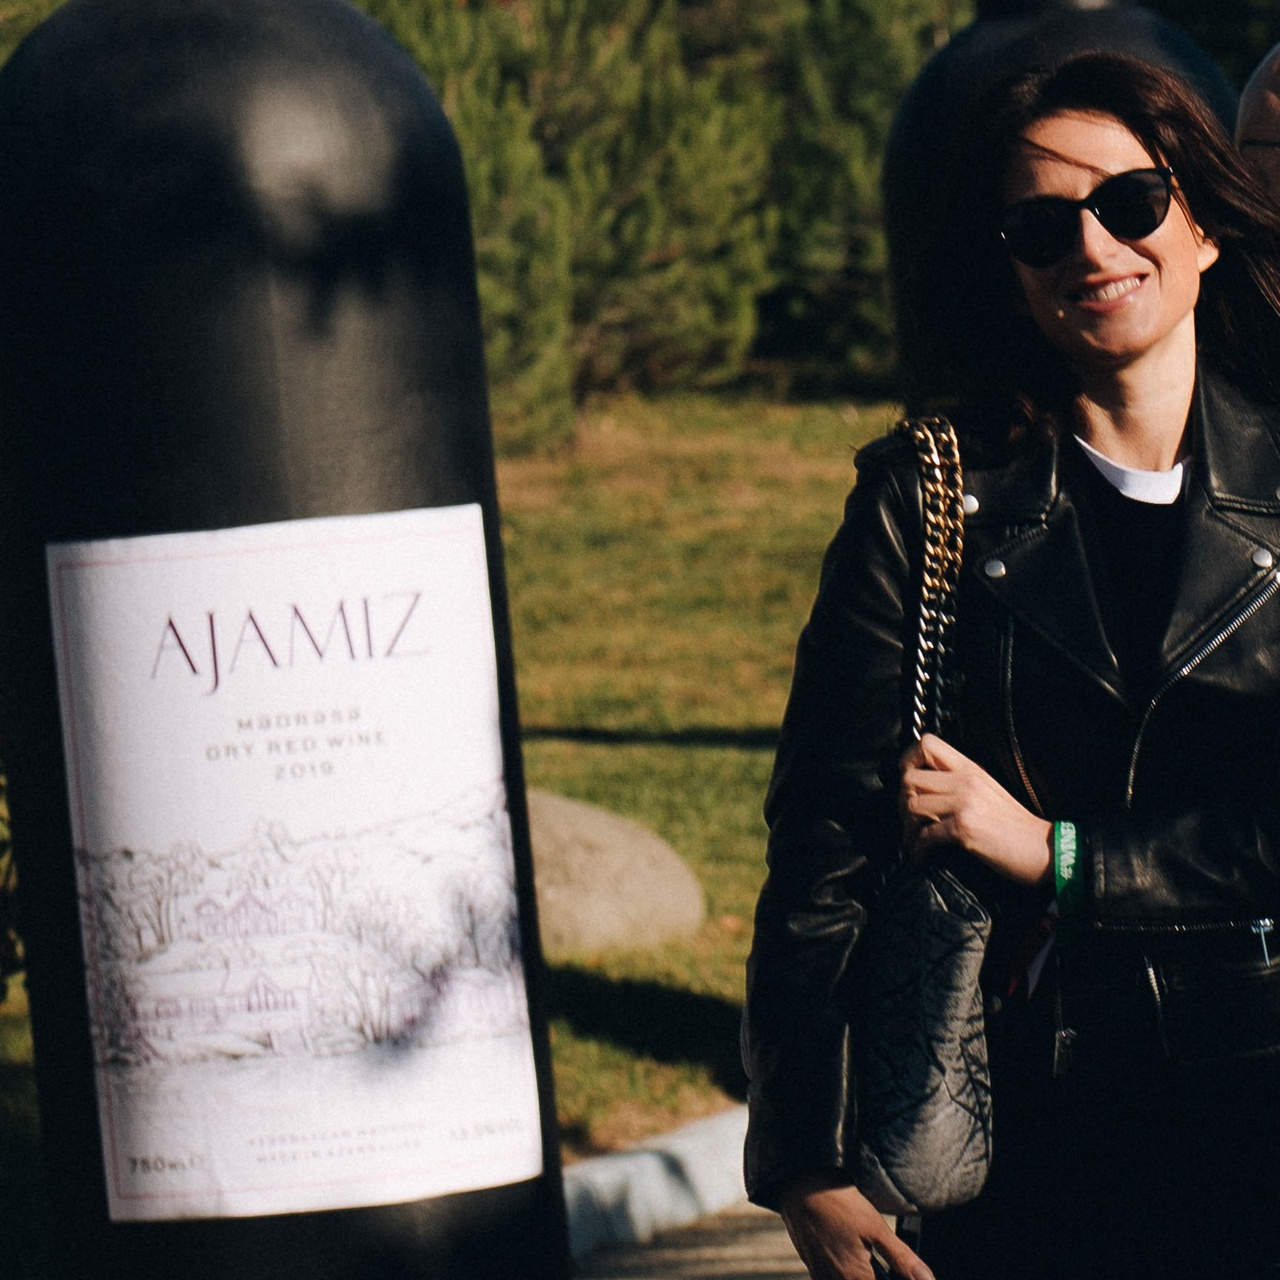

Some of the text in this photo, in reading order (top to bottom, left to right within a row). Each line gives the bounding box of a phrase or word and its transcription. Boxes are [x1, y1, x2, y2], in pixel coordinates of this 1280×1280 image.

[150, 590, 430, 696] AJAMIZ
[204, 729, 387, 762] DRY RED WINE
